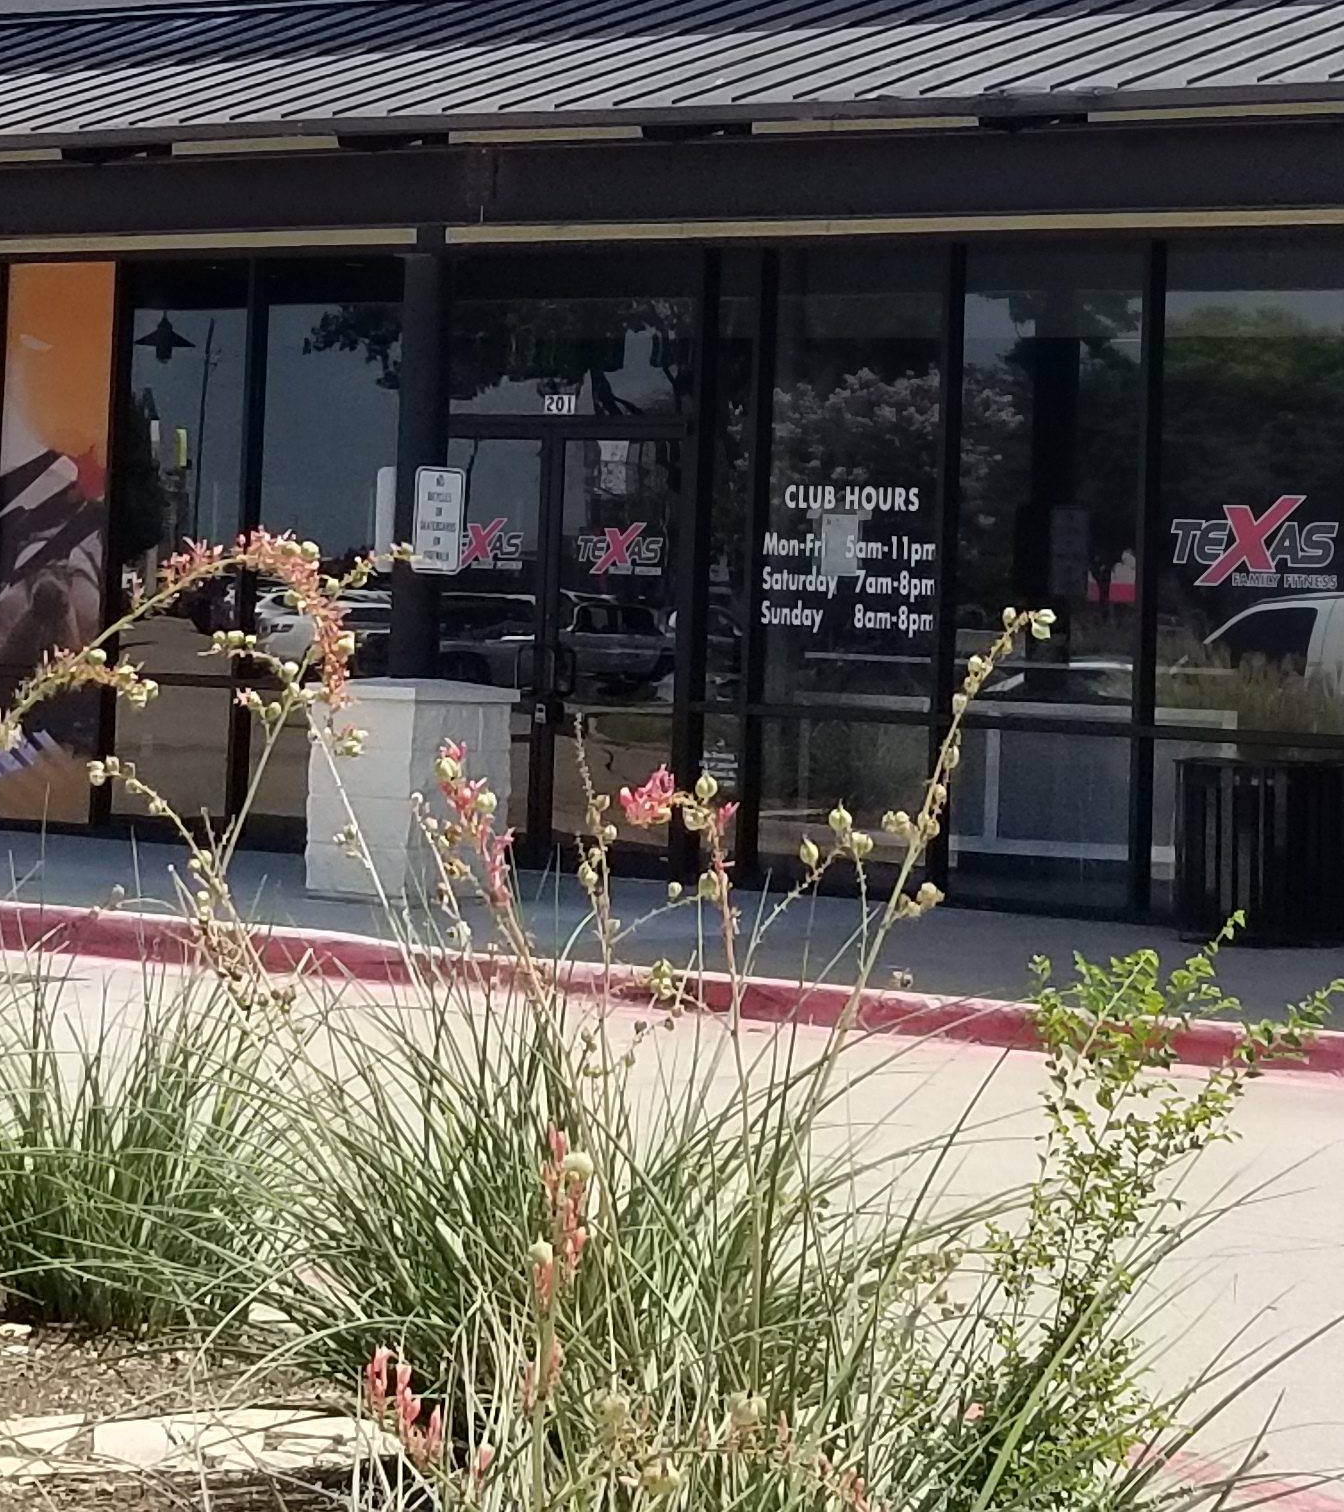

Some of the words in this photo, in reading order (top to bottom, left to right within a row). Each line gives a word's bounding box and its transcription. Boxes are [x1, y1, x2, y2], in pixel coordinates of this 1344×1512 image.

[546, 396, 573, 414] 201
[784, 484, 836, 510] CLUB
[844, 486, 920, 512] HOURS
[460, 517, 524, 568] XAS
[576, 521, 664, 575] TEXAS
[762, 531, 827, 557] Mon-Fri
[844, 534, 936, 568] 5am-11pm
[1170, 494, 1340, 586] TEXAS
[761, 565, 839, 600] Saturday
[854, 569, 936, 603] 7am-8pm
[1231, 572, 1281, 588] FAMILY
[1284, 573, 1338, 589] FITNESS
[760, 599, 824, 634] Sunday
[853, 603, 935, 639] 8am-8pm
